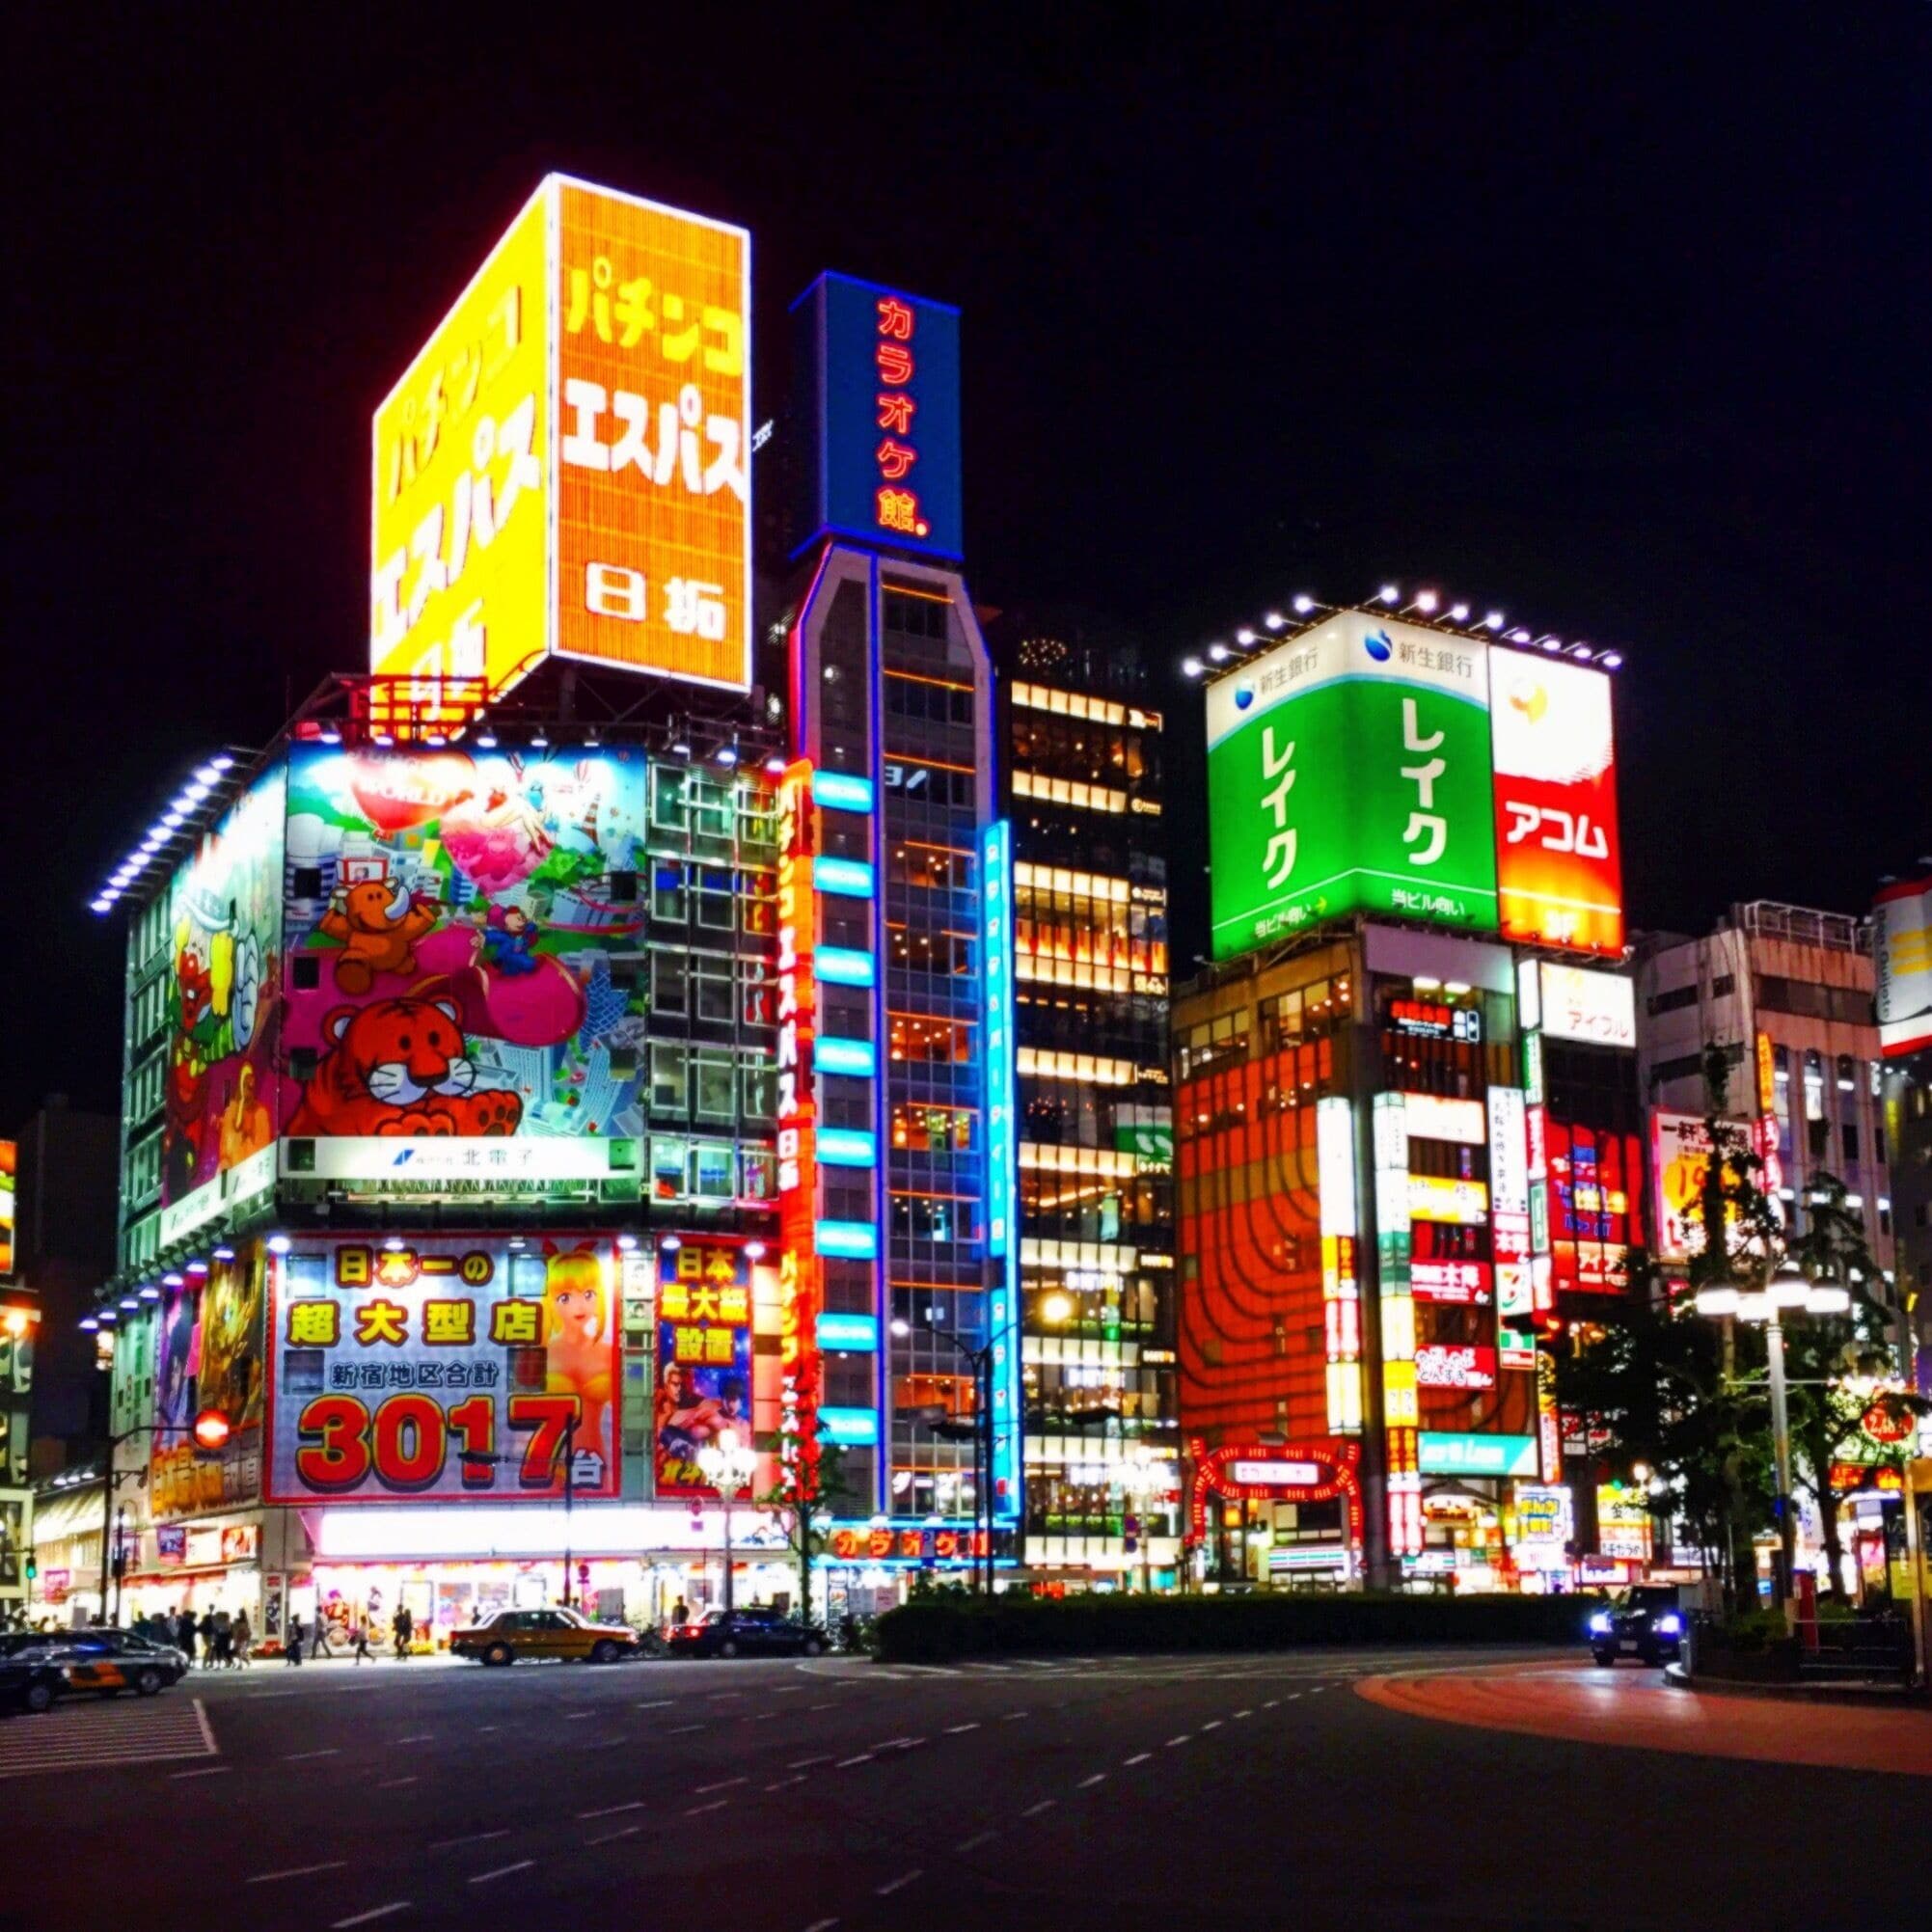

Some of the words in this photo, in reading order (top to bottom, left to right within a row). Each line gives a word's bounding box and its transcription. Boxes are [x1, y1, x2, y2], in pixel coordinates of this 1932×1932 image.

[566, 257, 743, 375] パチンコ
[391, 286, 522, 506] パチンコ
[562, 377, 745, 502] エスパス
[372, 393, 542, 657] エスパス
[1260, 647, 1319, 695] 新生銀行
[1400, 642, 1473, 679] 新生銀行
[1262, 726, 1296, 890] レイク
[1401, 698, 1446, 865] レイク
[1506, 802, 1608, 858] アコム
[778, 926, 798, 1120] エスパス
[1569, 1011, 1628, 1038] アイフル
[338, 1246, 493, 1288] 日本一の
[678, 1247, 735, 1280] 日本
[287, 1299, 543, 1347] 超大型店
[331, 1361, 499, 1389] 新宿地区合計
[297, 1395, 582, 1491] 3017
[571, 1450, 604, 1487] 台
